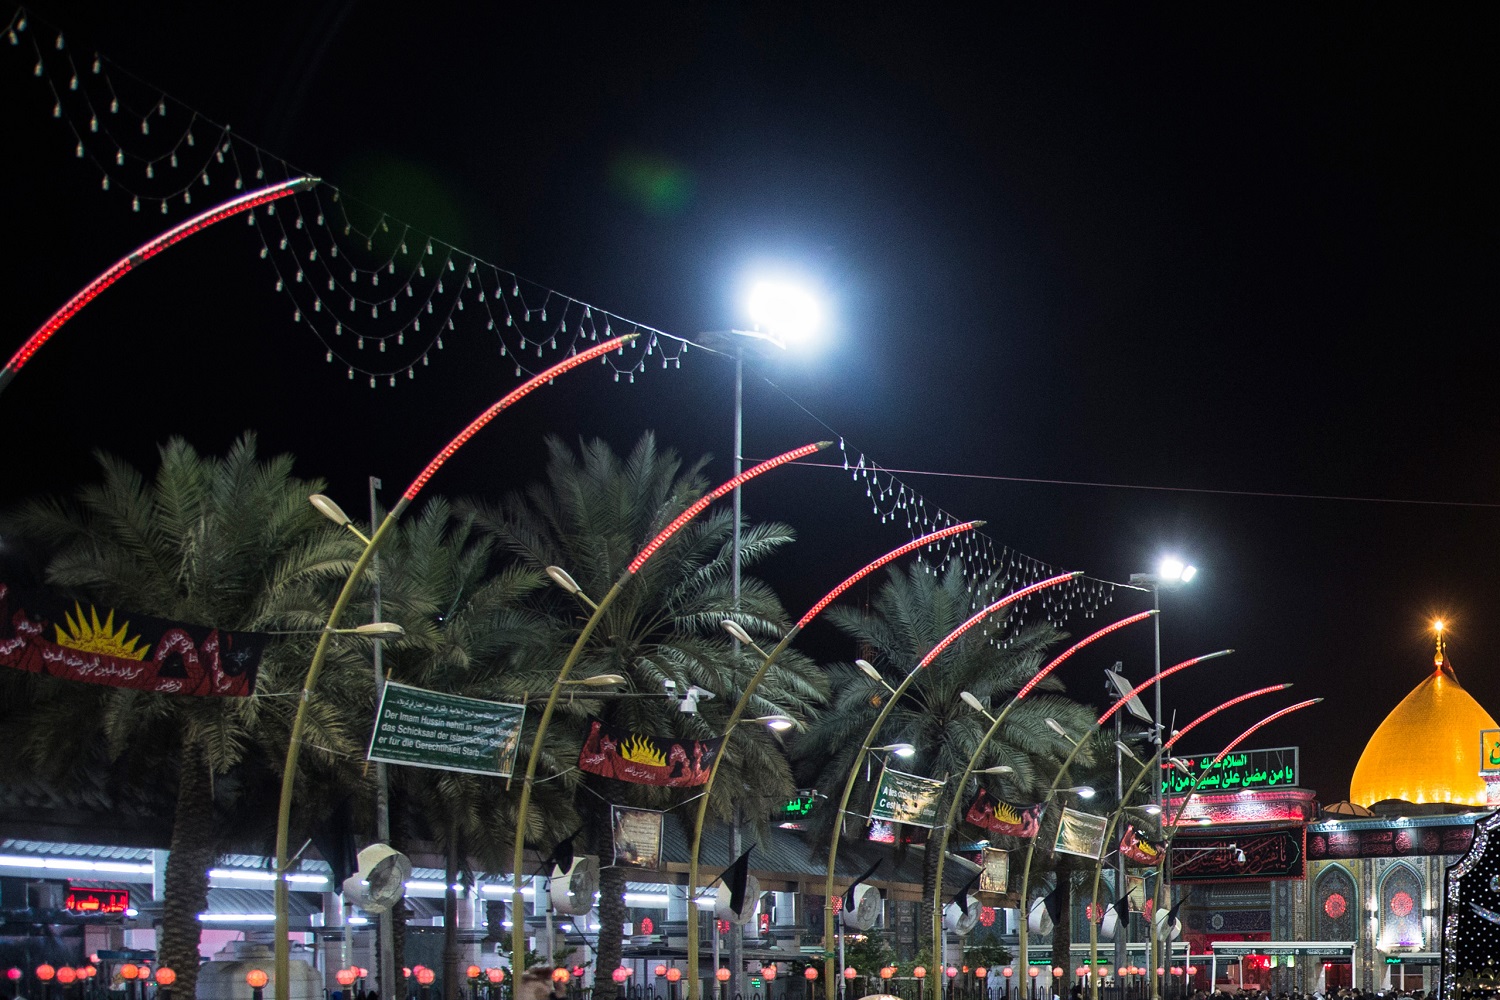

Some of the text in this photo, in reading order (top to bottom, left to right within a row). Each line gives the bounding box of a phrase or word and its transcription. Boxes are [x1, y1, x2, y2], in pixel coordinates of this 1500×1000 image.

[384, 709, 399, 719] Der
[400, 712, 419, 723] Imam
[381, 723, 396, 733] das
[437, 731, 449, 740] der
[378, 736, 388, 744] er
[402, 738, 414, 748] die
[1200, 757, 1222, 771] عليك
[1222, 754, 1248, 770] السلام
[1269, 771, 1284, 785] من
[1285, 766, 1294, 784] يا
[1175, 777, 1189, 792] من
